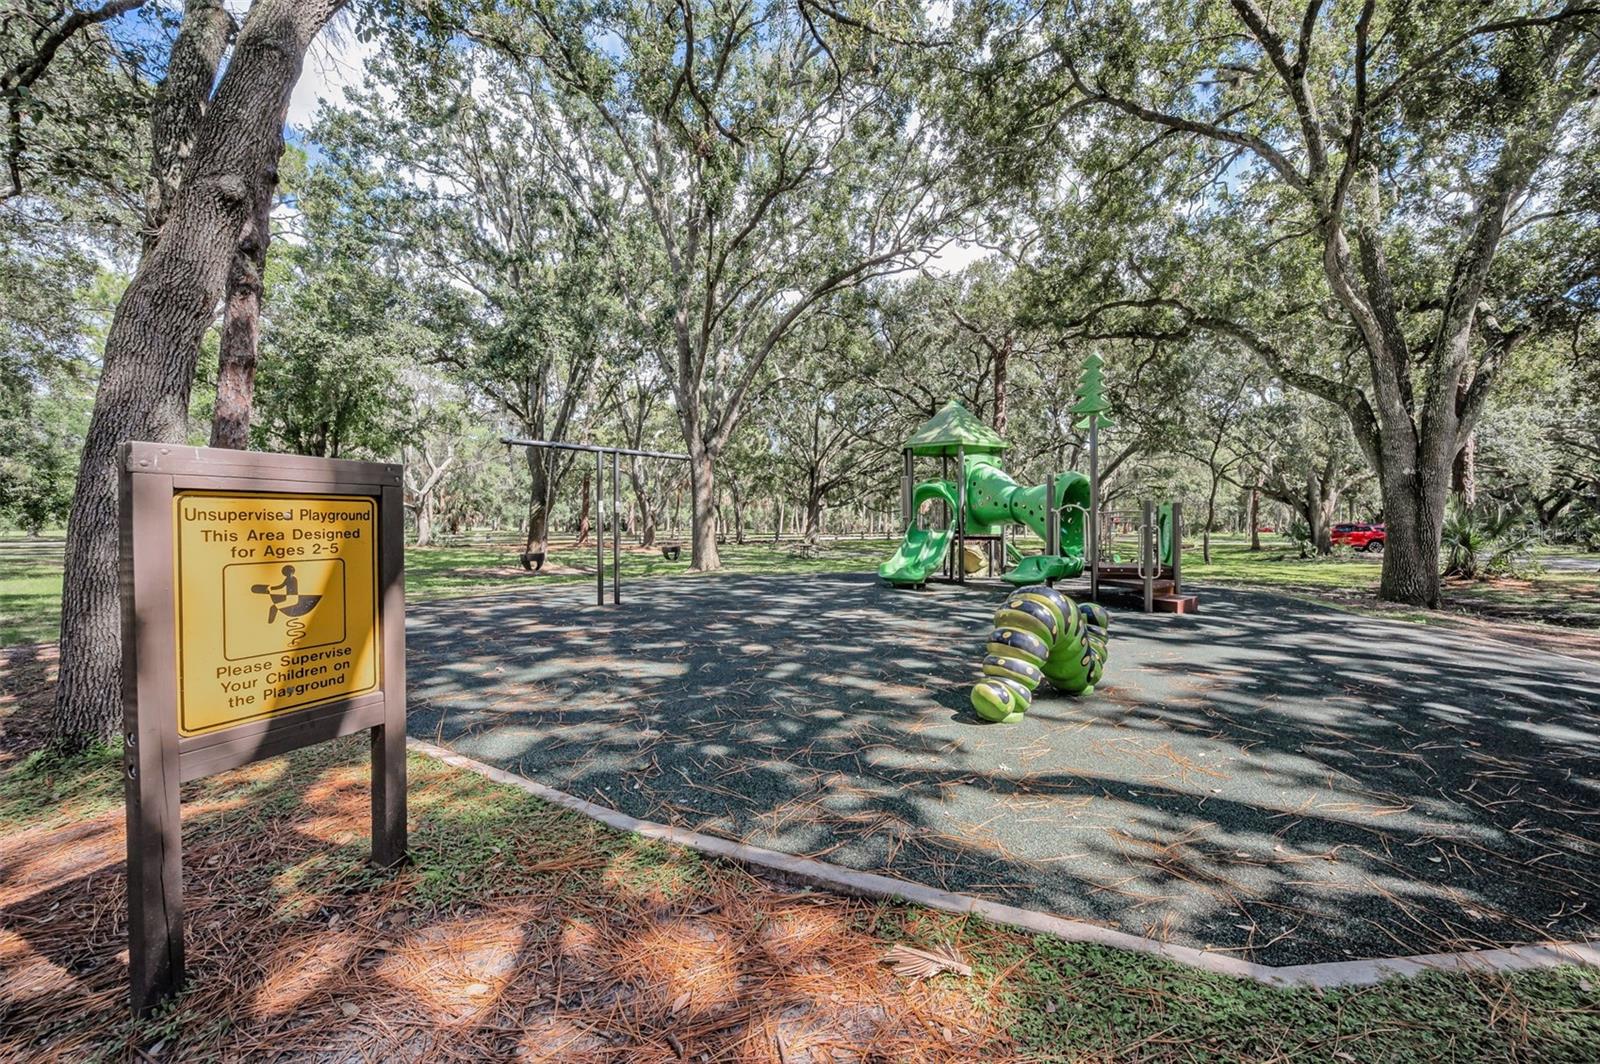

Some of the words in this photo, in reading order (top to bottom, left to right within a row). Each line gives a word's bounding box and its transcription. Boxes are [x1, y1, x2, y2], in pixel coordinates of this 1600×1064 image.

[184, 508, 293, 522] Unsupervised
[300, 509, 370, 523] Playground
[201, 530, 238, 542] This
[247, 529, 285, 541] Area
[293, 529, 360, 540] Designed
[231, 546, 256, 558] for
[264, 545, 304, 558] Ages
[312, 543, 339, 554] 2-5
[216, 659, 272, 679] Please
[281, 646, 352, 666] Supervise
[221, 679, 257, 693] Your
[266, 664, 327, 684] Children
[334, 661, 350, 671] on
[228, 694, 255, 708] the
[264, 674, 345, 700] Playground
